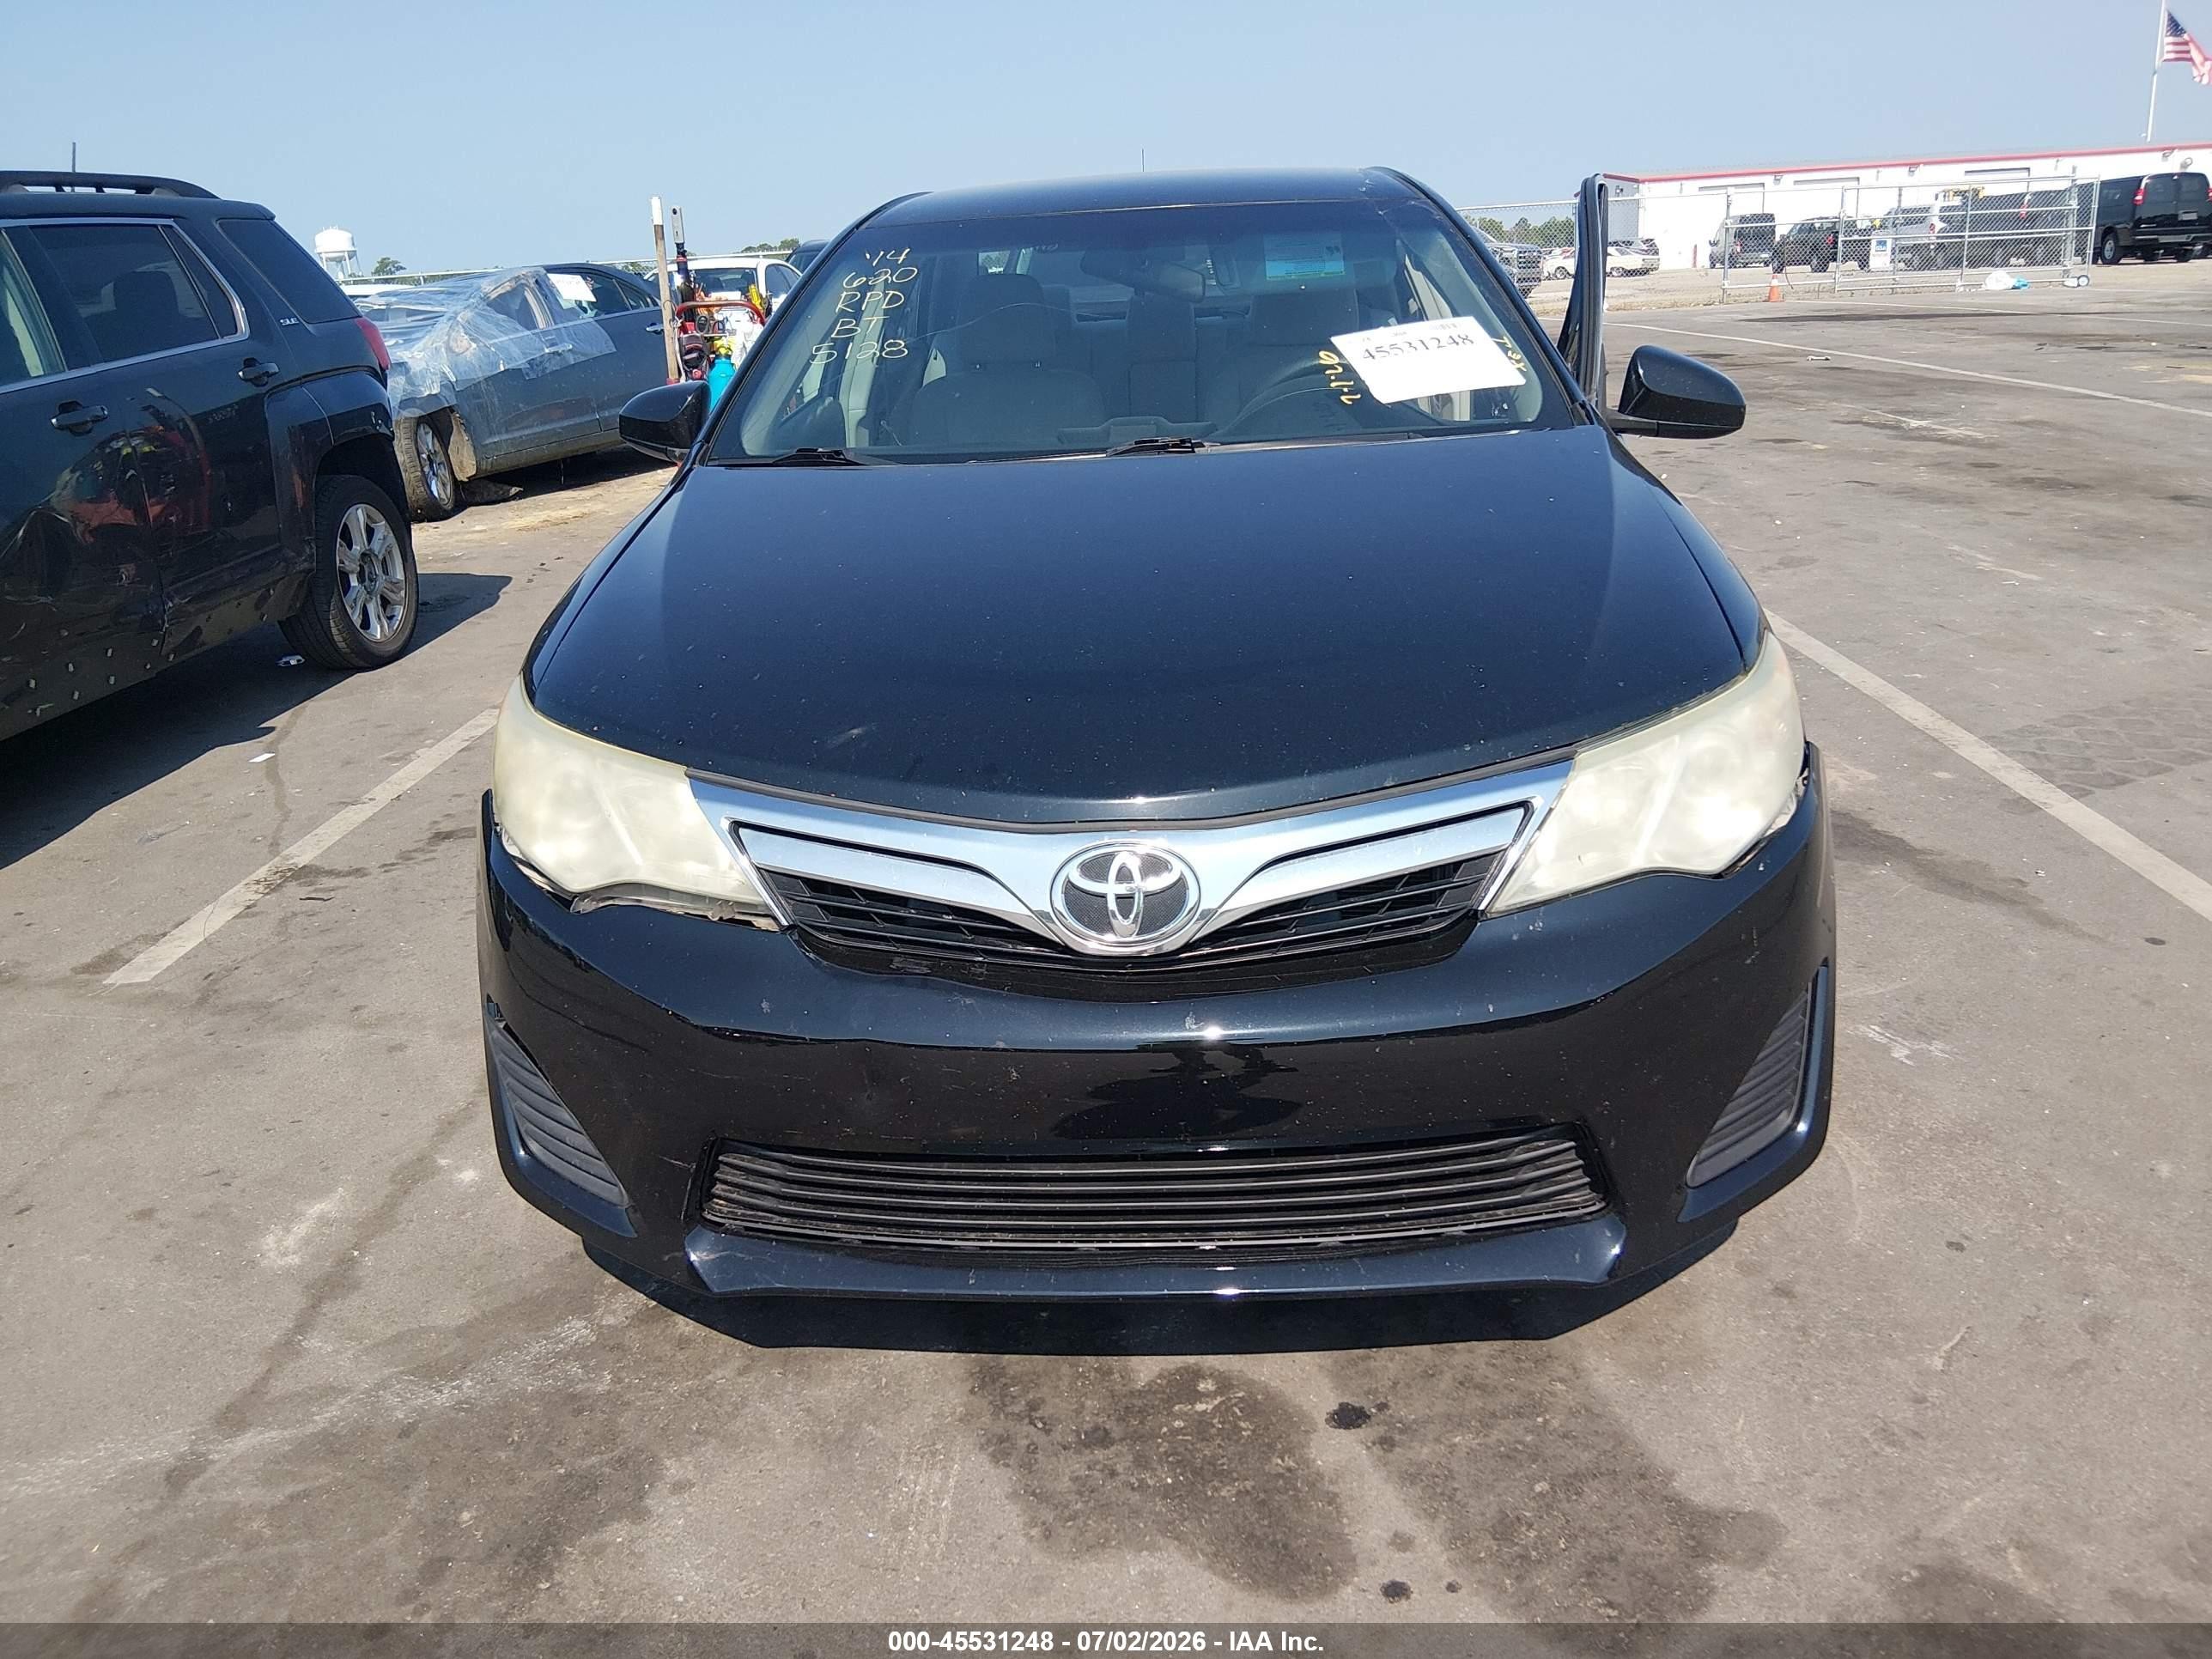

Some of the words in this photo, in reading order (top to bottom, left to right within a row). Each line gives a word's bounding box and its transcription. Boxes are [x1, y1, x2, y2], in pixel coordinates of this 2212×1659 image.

[835, 290, 905, 313] RPD
[809, 339, 908, 364] 5128
[1362, 333, 1475, 361] 45531248
